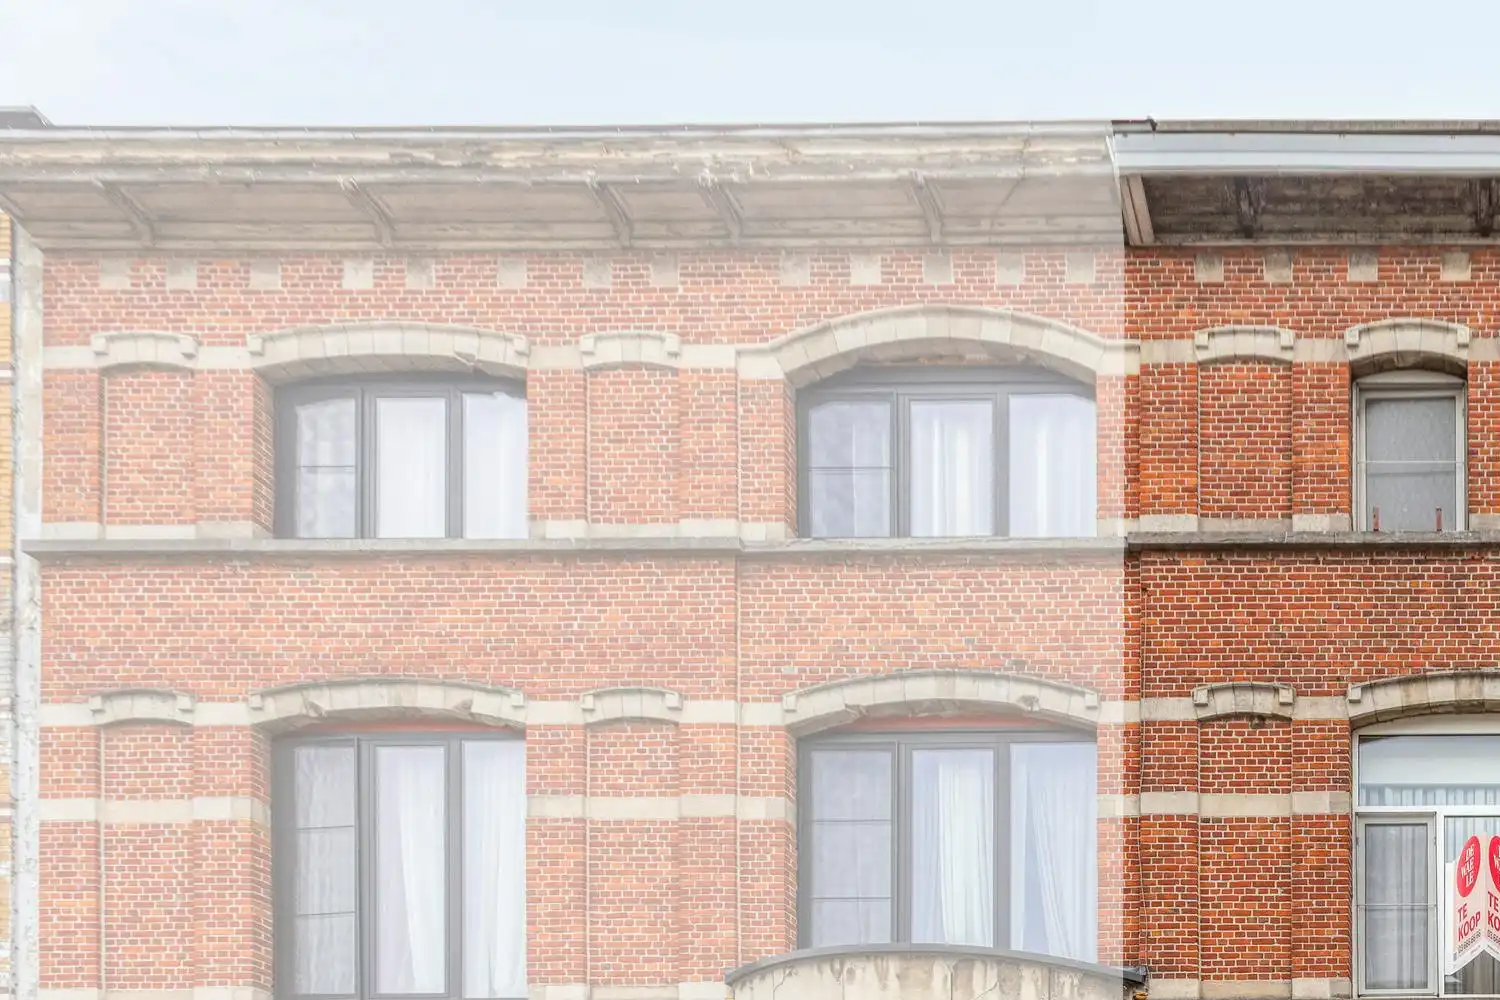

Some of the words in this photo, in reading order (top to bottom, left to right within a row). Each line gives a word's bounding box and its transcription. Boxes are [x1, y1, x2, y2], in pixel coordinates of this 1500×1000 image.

[1465, 844, 1475, 861] DE
[1461, 856, 1475, 878] WAE
[1465, 871, 1474, 887] LE
[1487, 891, 1499, 913] TE
[1458, 903, 1468, 922] TE
[1458, 911, 1481, 941] KOOP
